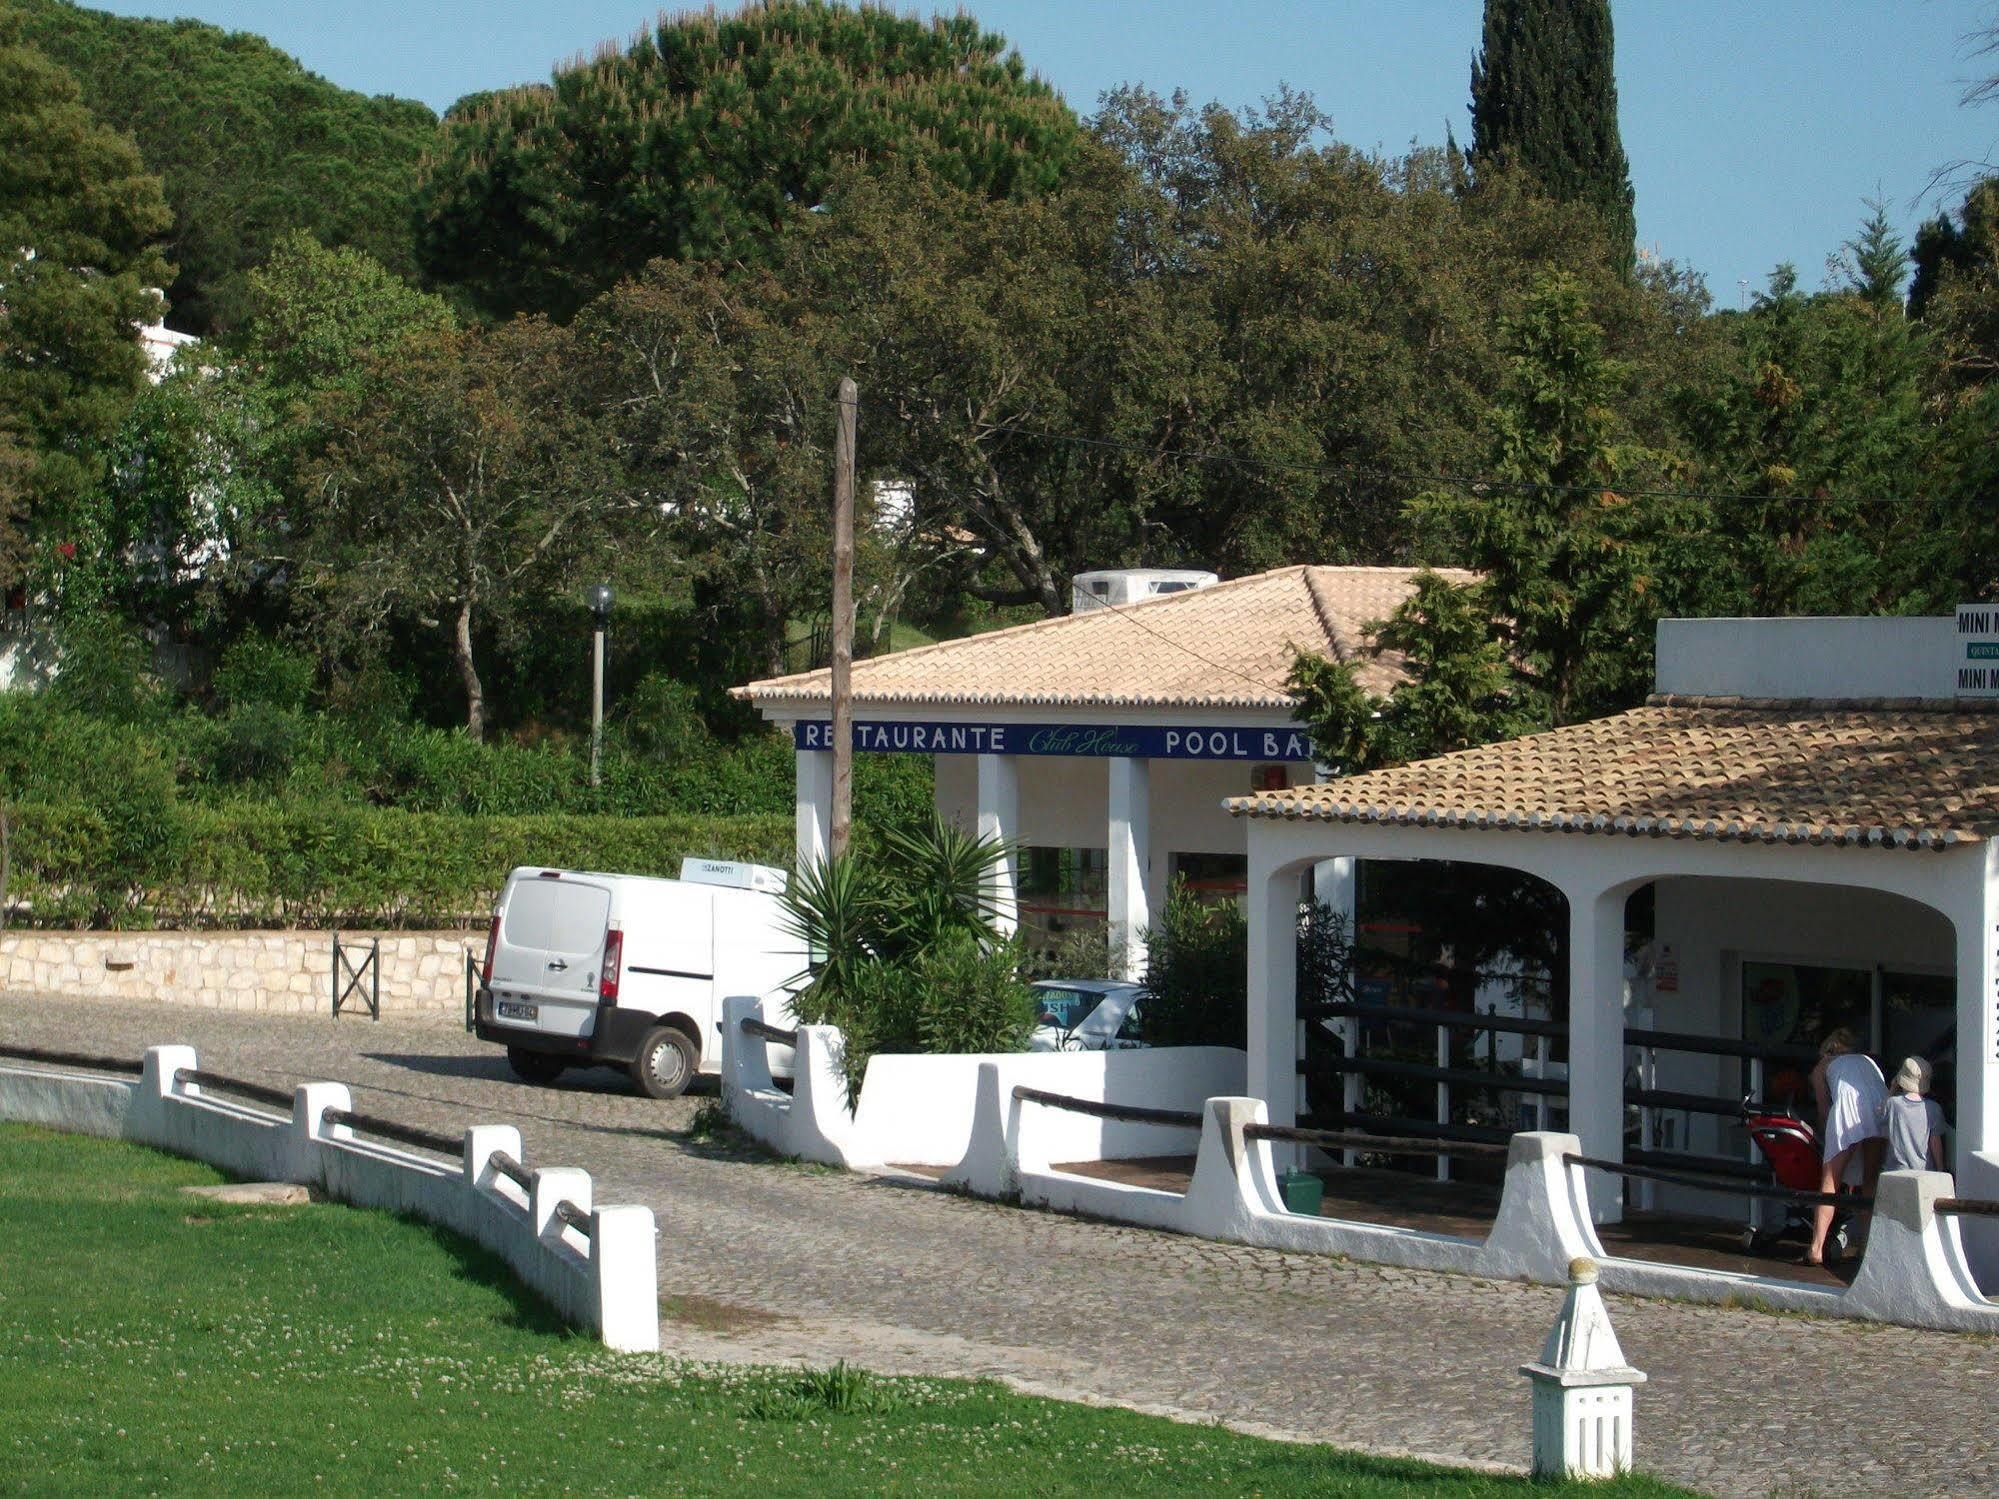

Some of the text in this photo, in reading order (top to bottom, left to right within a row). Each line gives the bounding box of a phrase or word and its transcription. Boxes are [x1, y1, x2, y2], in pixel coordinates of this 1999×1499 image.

[1958, 612, 1989, 633] MINI
[1958, 668, 1986, 689] MINI
[806, 724, 1005, 751] RETAURANTE
[1166, 730, 1247, 756] POOL
